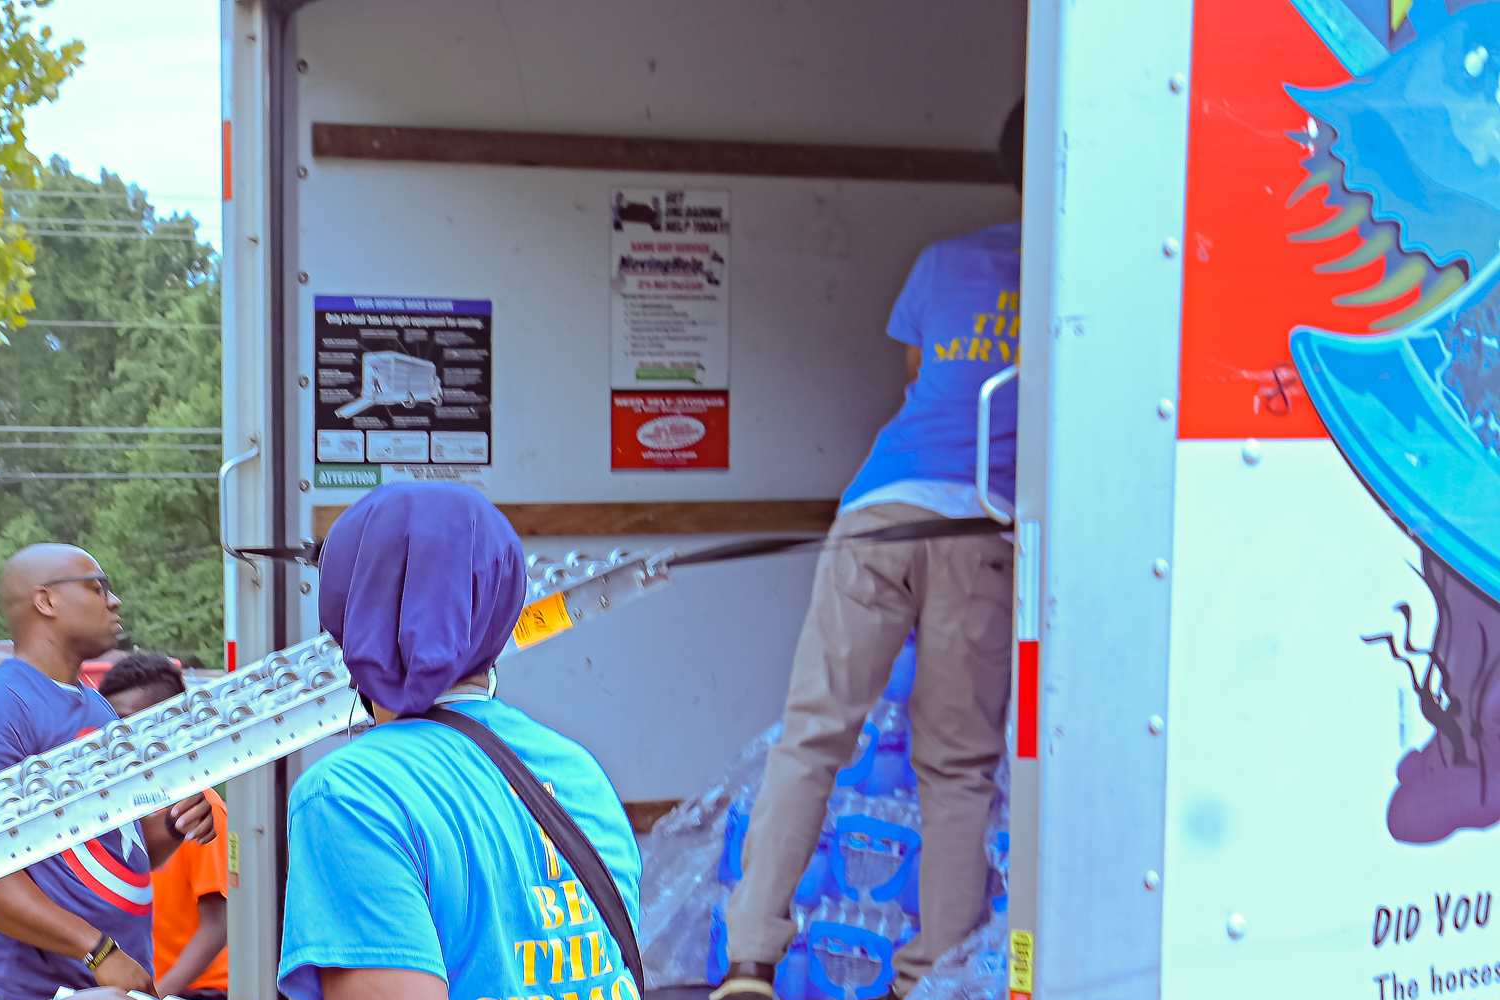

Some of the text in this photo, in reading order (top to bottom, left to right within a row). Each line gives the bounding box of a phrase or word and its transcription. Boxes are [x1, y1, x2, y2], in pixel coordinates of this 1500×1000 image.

[973, 312, 1021, 338] TH
[318, 470, 378, 486] ATTENTION
[532, 880, 594, 930] BE
[1372, 890, 1493, 948] DID YOU
[514, 931, 613, 987] THE
